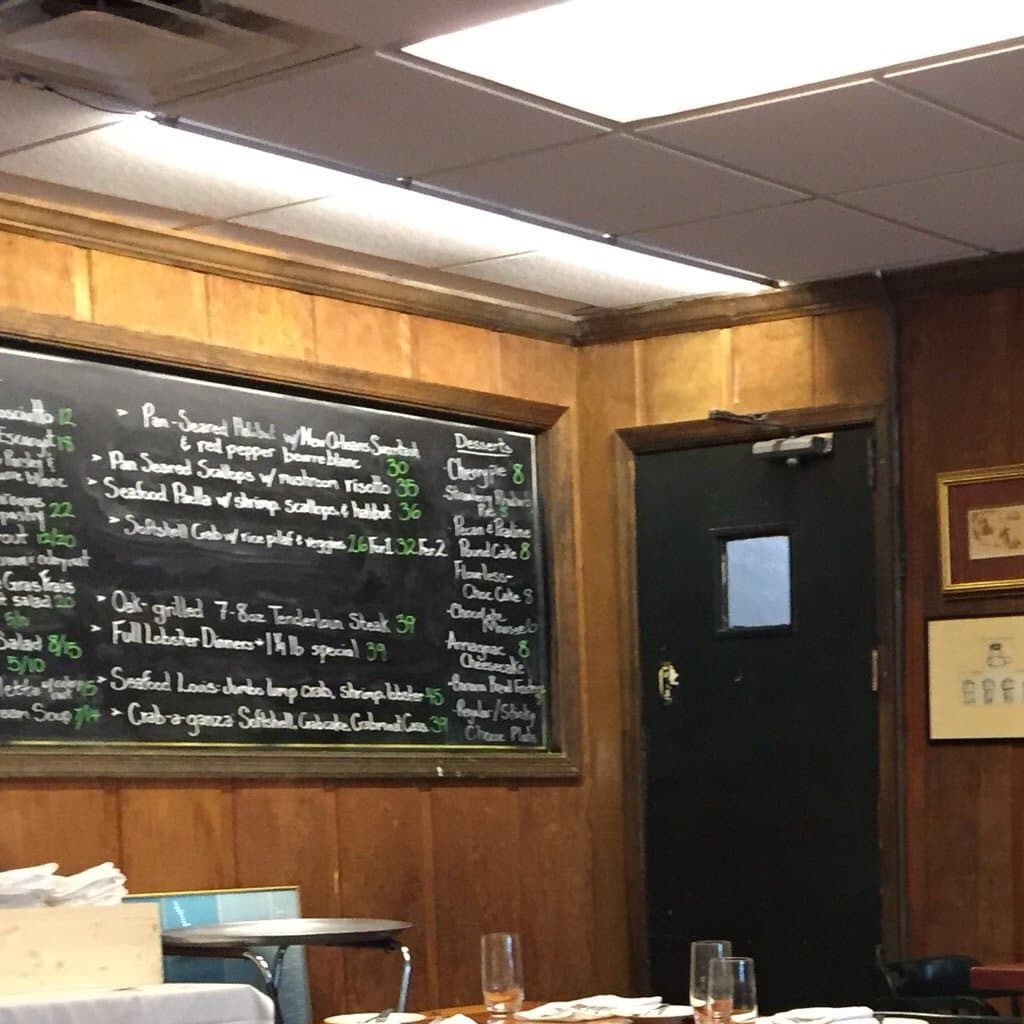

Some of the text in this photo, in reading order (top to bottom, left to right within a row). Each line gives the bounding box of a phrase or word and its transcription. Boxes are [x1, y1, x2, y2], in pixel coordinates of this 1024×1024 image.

[453, 432, 514, 454] Desserts
[196, 437, 224, 454] red
[225, 444, 277, 461] pepper
[386, 458, 410, 477] 30
[108, 450, 138, 470] Pan
[140, 452, 193, 476] Seared
[395, 477, 420, 498] 35
[512, 463, 525, 485] 8
[48, 501, 76, 518] 22
[102, 476, 169, 502] Seafood
[399, 501, 422, 521] 36
[395, 537, 418, 556] 32
[518, 541, 531, 561] 8
[494, 585, 522, 603] Cake
[151, 595, 205, 625] grilled
[348, 611, 392, 634] Steak
[394, 613, 417, 635] 39
[310, 638, 360, 664] special
[365, 641, 388, 663] 39
[517, 639, 531, 659] 8
[6, 655, 46, 675] 5/10
[109, 665, 173, 692] Seafood
